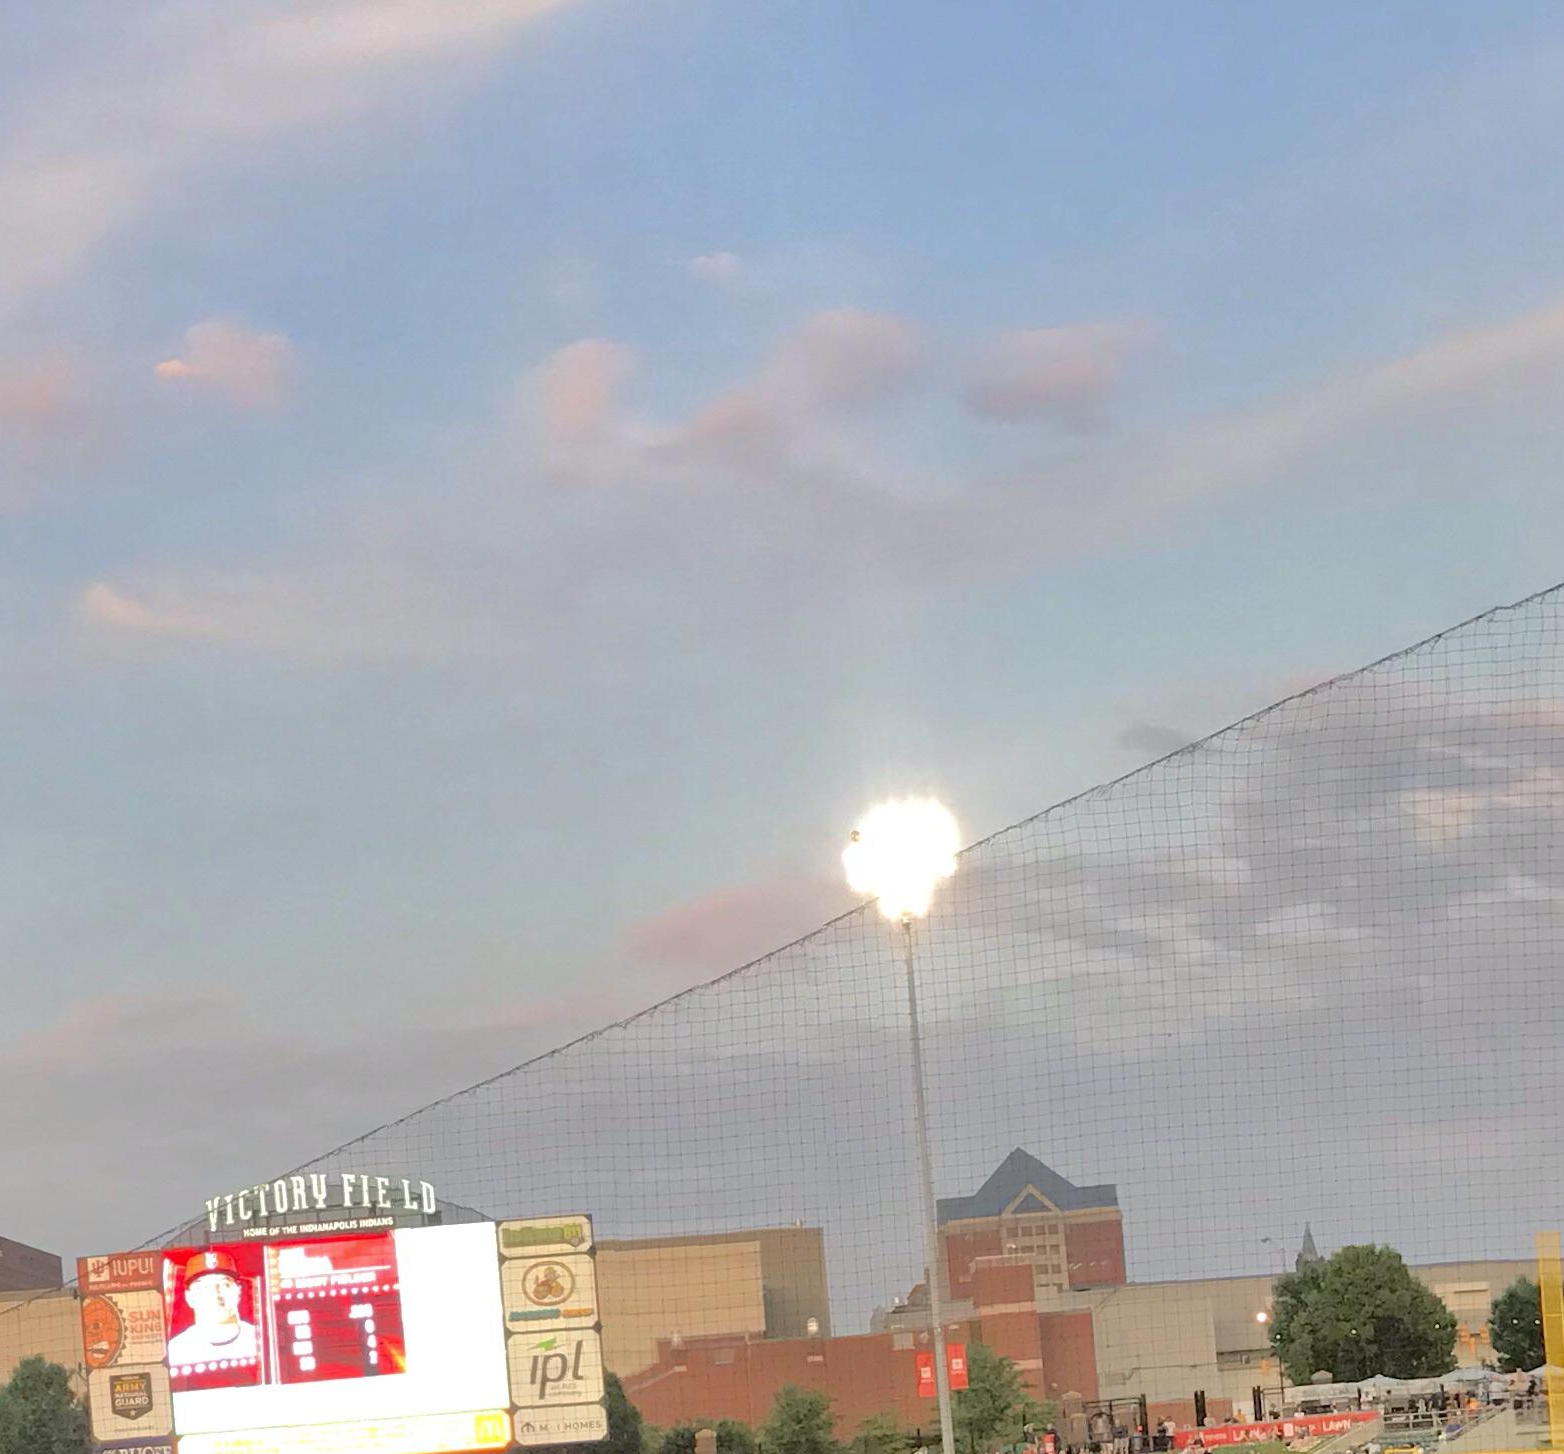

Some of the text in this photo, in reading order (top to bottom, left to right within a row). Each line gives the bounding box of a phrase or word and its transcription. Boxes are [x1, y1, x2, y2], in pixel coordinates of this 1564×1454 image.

[206, 1173, 437, 1232] VICTORY FIELD
[243, 1217, 394, 1237] HOME OF THE INDIANAPOLIS INDIANS
[112, 1257, 154, 1277] IUPUI
[129, 1309, 161, 1322] SUN
[129, 1321, 162, 1334] KING
[114, 1381, 147, 1393] ARMY
[114, 1396, 149, 1407] GUARD
